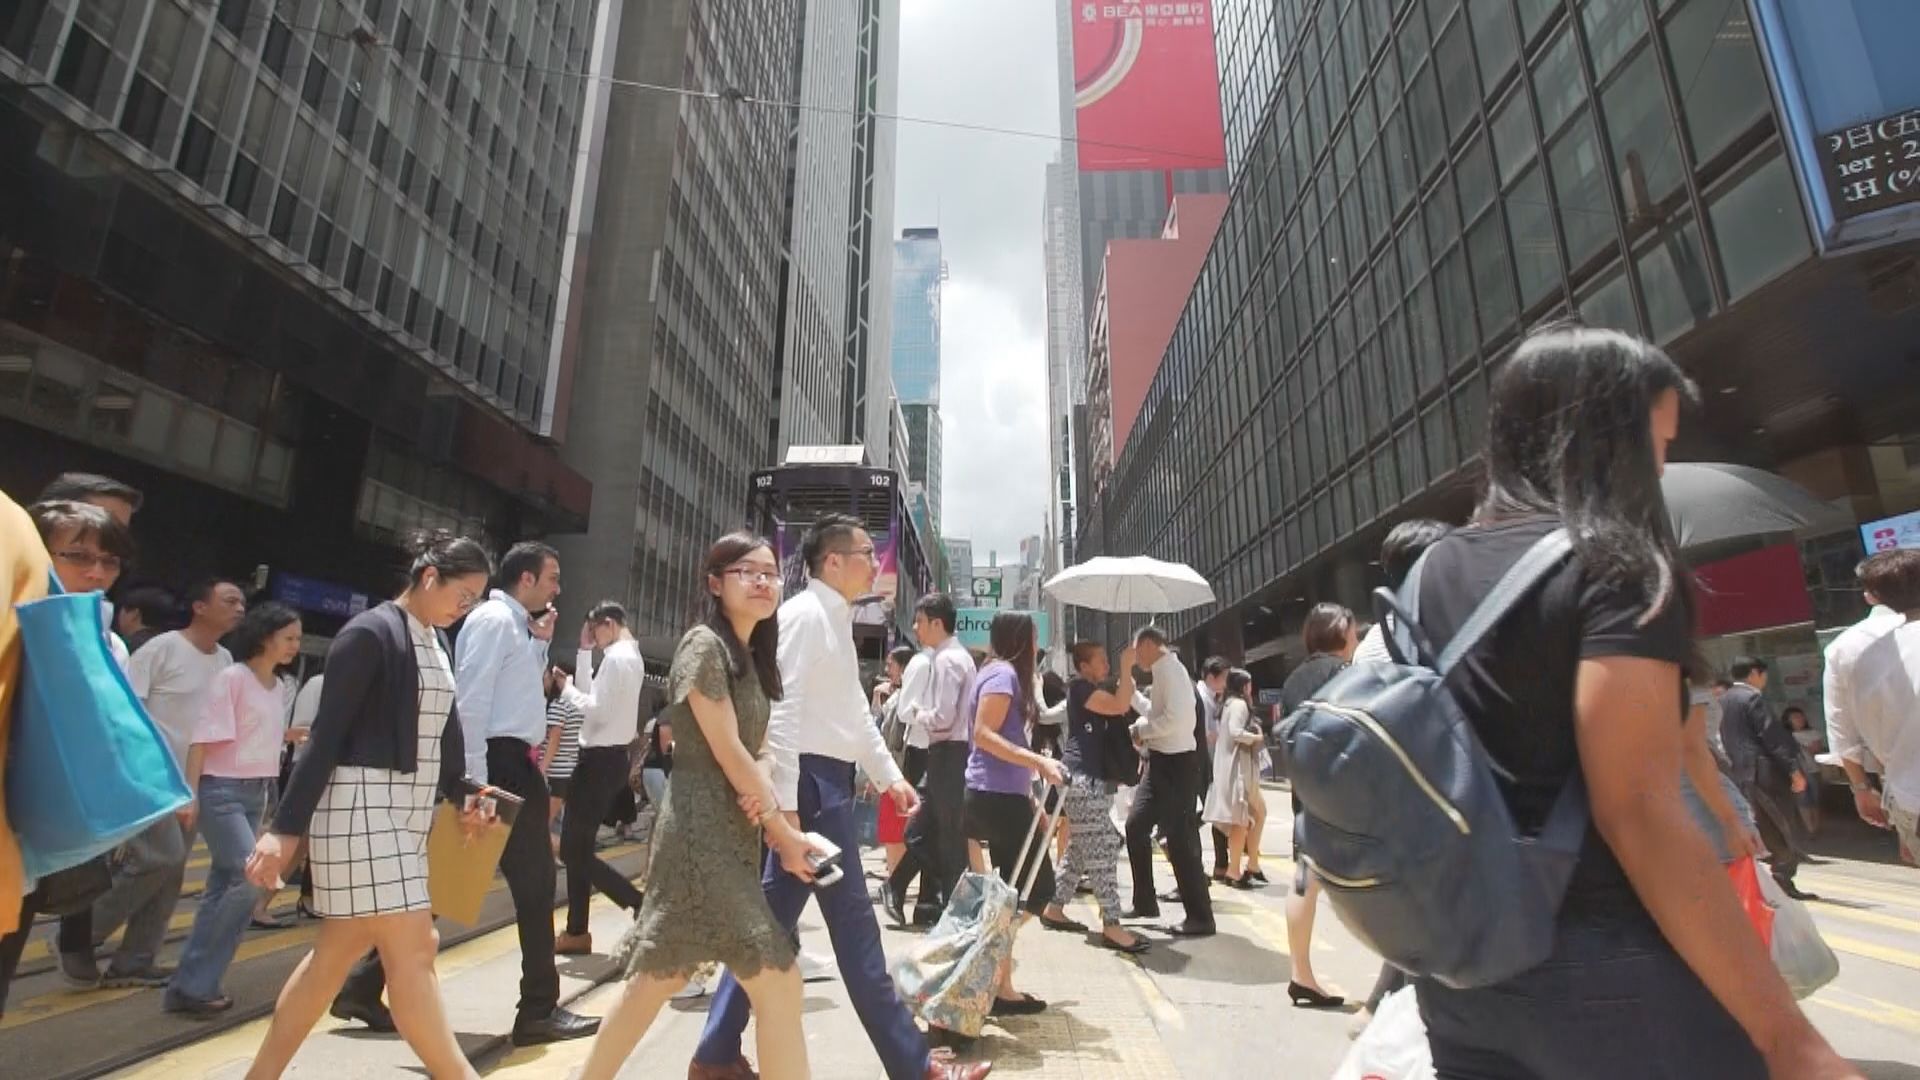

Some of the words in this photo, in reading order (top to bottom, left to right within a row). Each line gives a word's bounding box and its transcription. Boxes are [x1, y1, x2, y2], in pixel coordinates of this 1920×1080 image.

[1103, 6, 1142, 17] BEA
[756, 475, 773, 488] 102
[870, 474, 890, 487] 102
